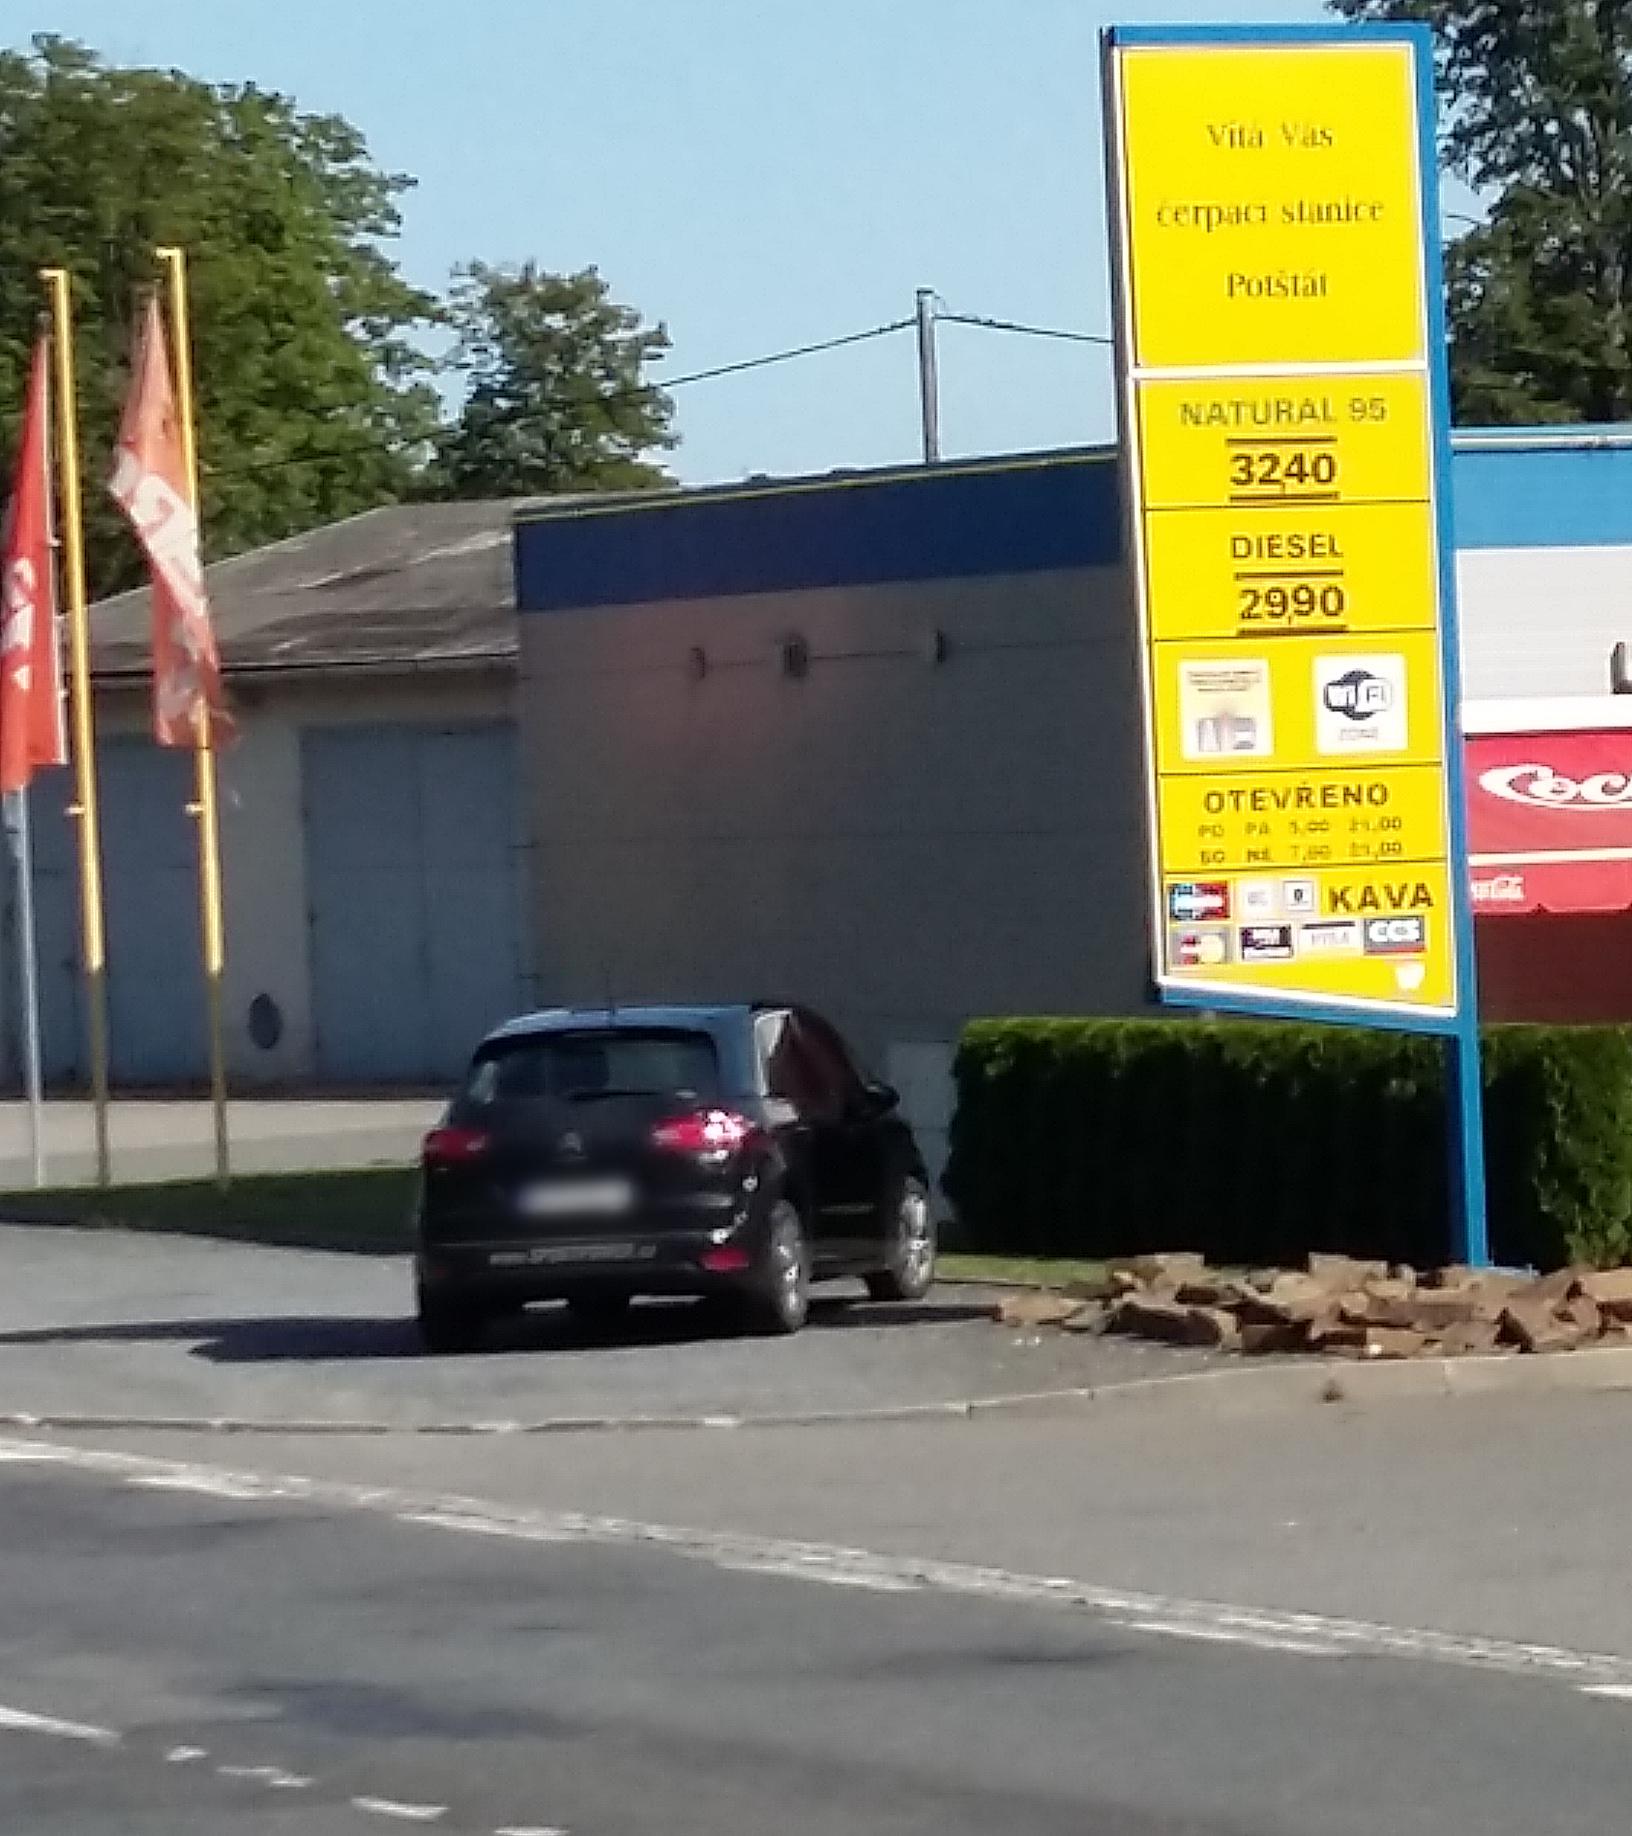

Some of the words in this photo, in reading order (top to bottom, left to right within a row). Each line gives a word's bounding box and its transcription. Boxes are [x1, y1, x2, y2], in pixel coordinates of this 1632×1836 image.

[1180, 398, 1337, 426] NATURAL
[1349, 397, 1387, 421] 95
[1232, 533, 1344, 559] DIESEL
[1203, 782, 1388, 813] OTEVŘENO
